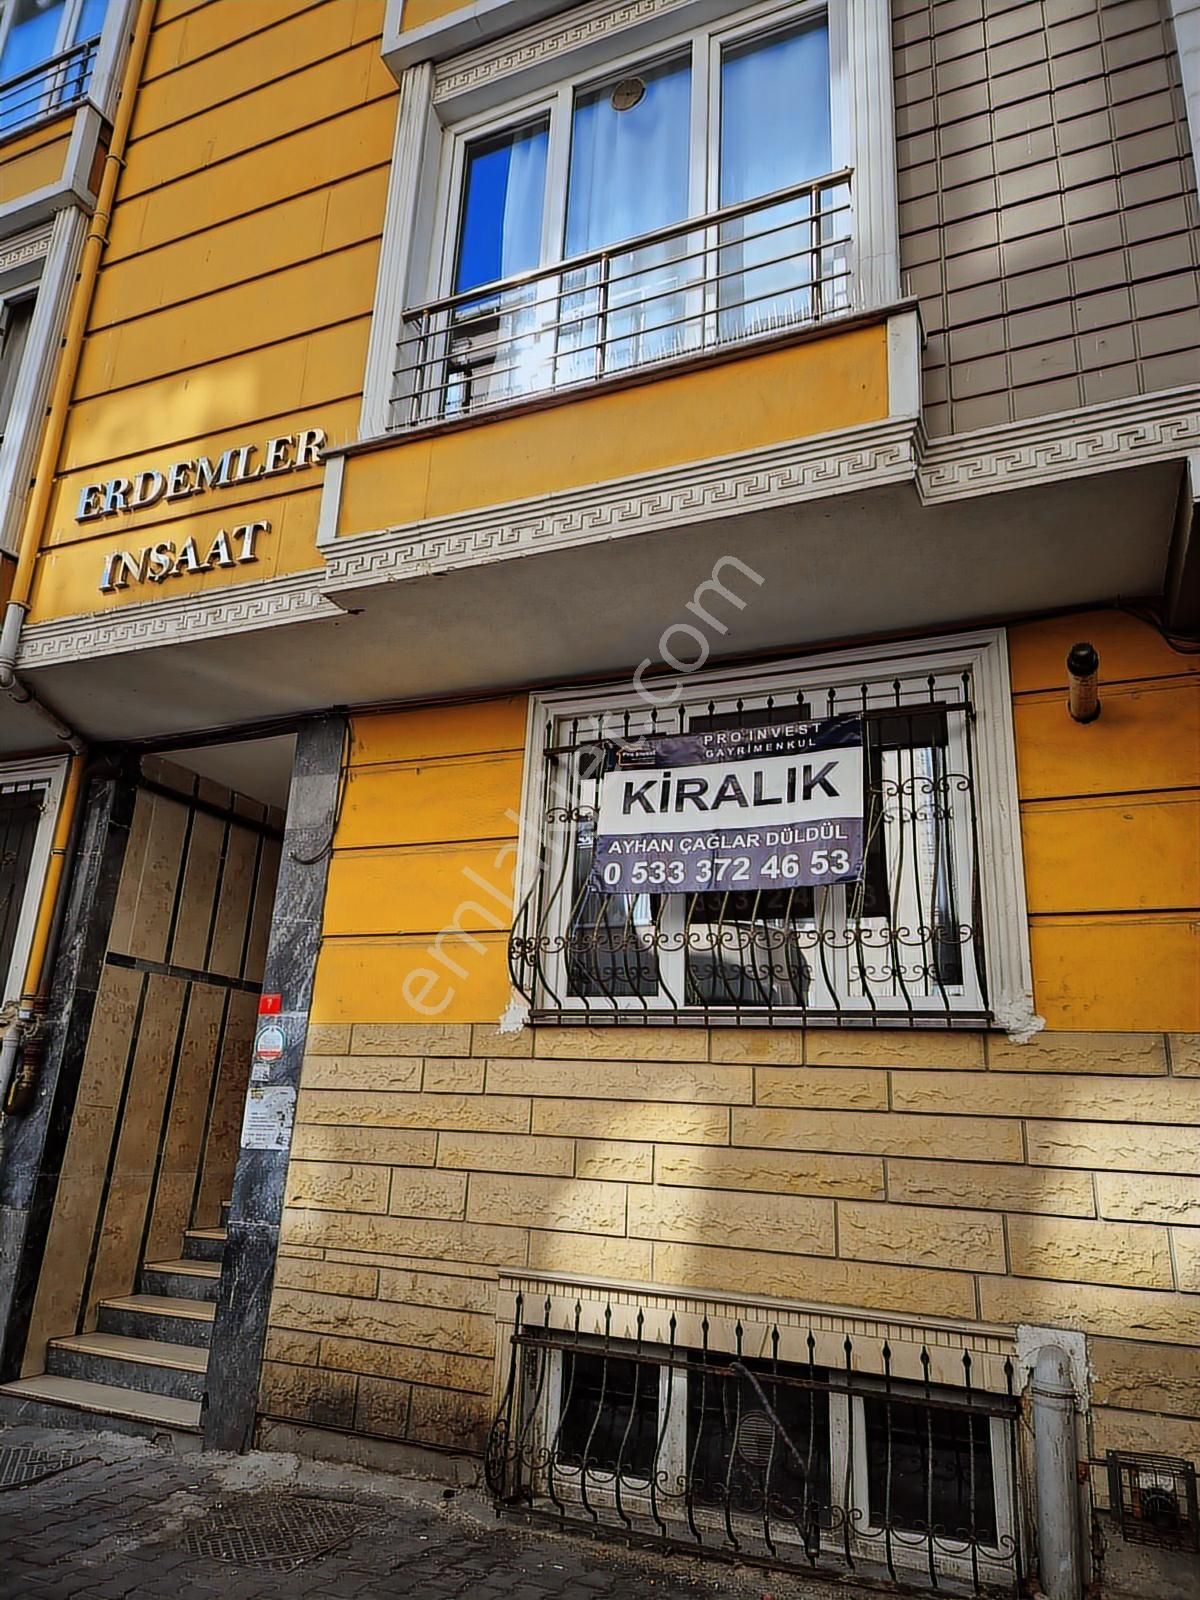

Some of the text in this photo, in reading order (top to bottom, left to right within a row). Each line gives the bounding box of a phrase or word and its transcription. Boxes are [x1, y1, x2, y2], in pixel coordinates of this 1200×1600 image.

[76, 428, 328, 521] ERDEMLER
[704, 722, 821, 746] PRO INVEST
[622, 761, 840, 815] KİRALIK
[608, 822, 848, 856] AYHAN ÇAĞLAR DÜLDÜL
[603, 850, 850, 885] 0 533 372 46 53
